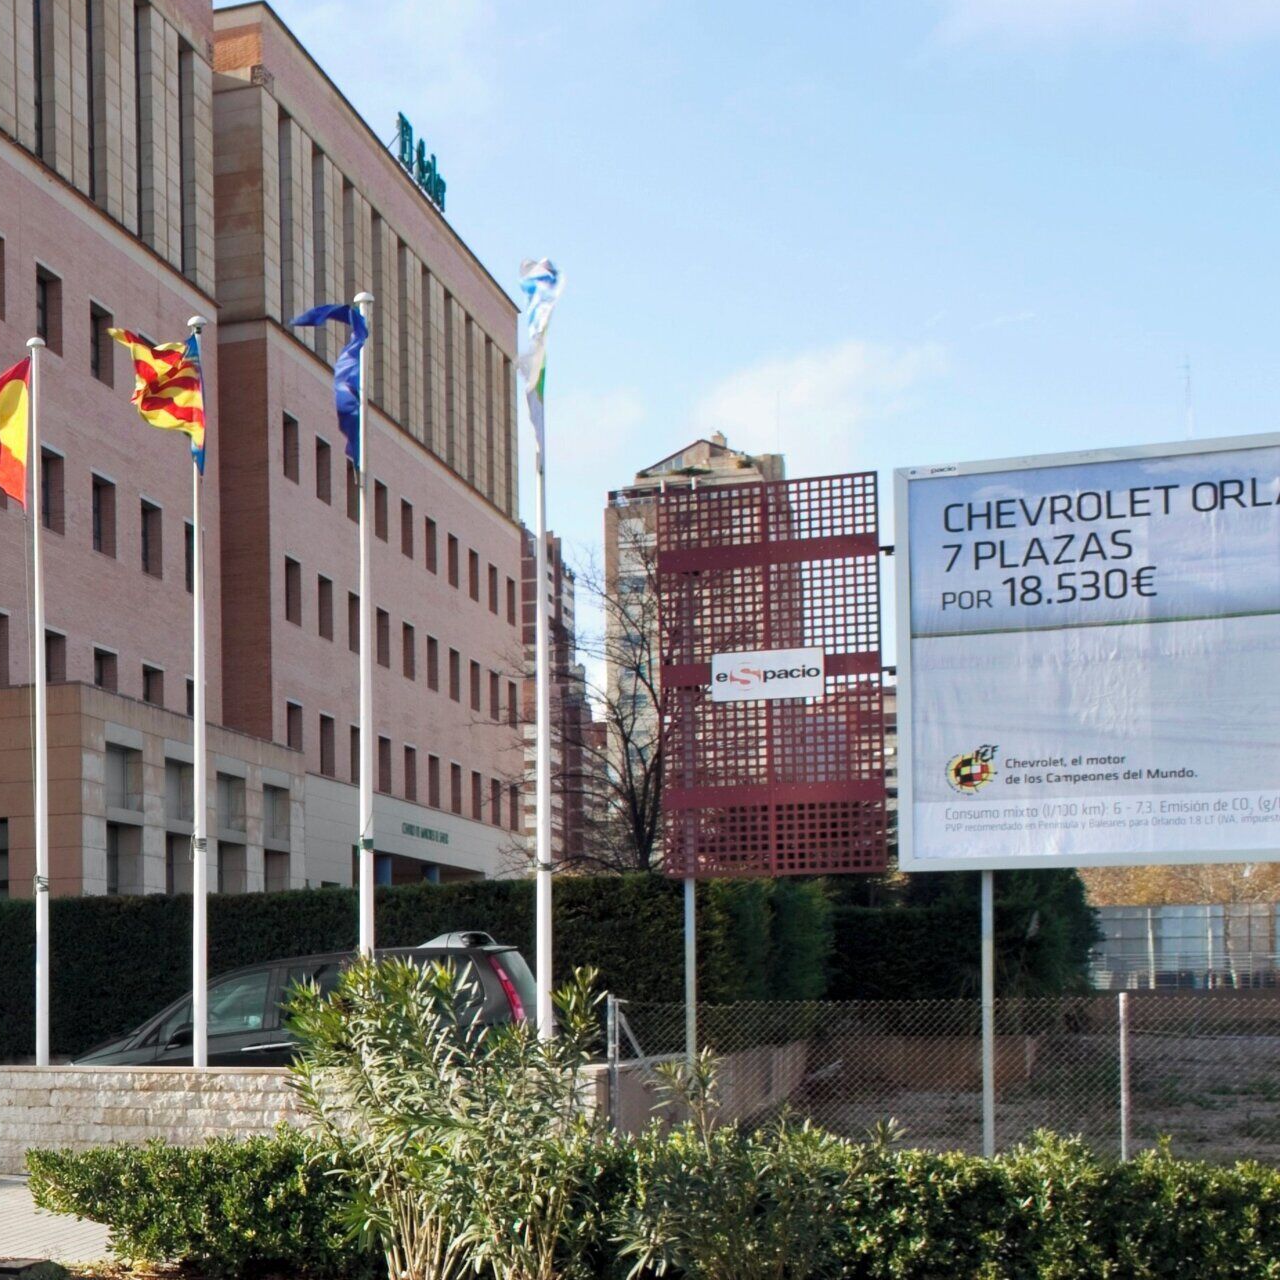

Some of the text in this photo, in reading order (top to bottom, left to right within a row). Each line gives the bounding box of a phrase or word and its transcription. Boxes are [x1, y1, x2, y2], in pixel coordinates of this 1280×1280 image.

[943, 477, 1280, 532] CHEVROLET ORL
[942, 529, 1133, 572] 7 PLAZAS
[941, 566, 1158, 611] POR 18.530€
[1005, 755, 1126, 769] Chevrolet, el motor
[1005, 767, 1198, 785] de los Campeones del Mundo.
[945, 807, 1000, 821] Consumo
[1113, 801, 1122, 815] 6
[1213, 799, 1228, 811] de
[945, 823, 962, 832] PVP
[965, 821, 1022, 831] recomendado
[1128, 818, 1149, 828] para
[1151, 816, 1186, 826] Orlando
[1205, 815, 1214, 825] LT
